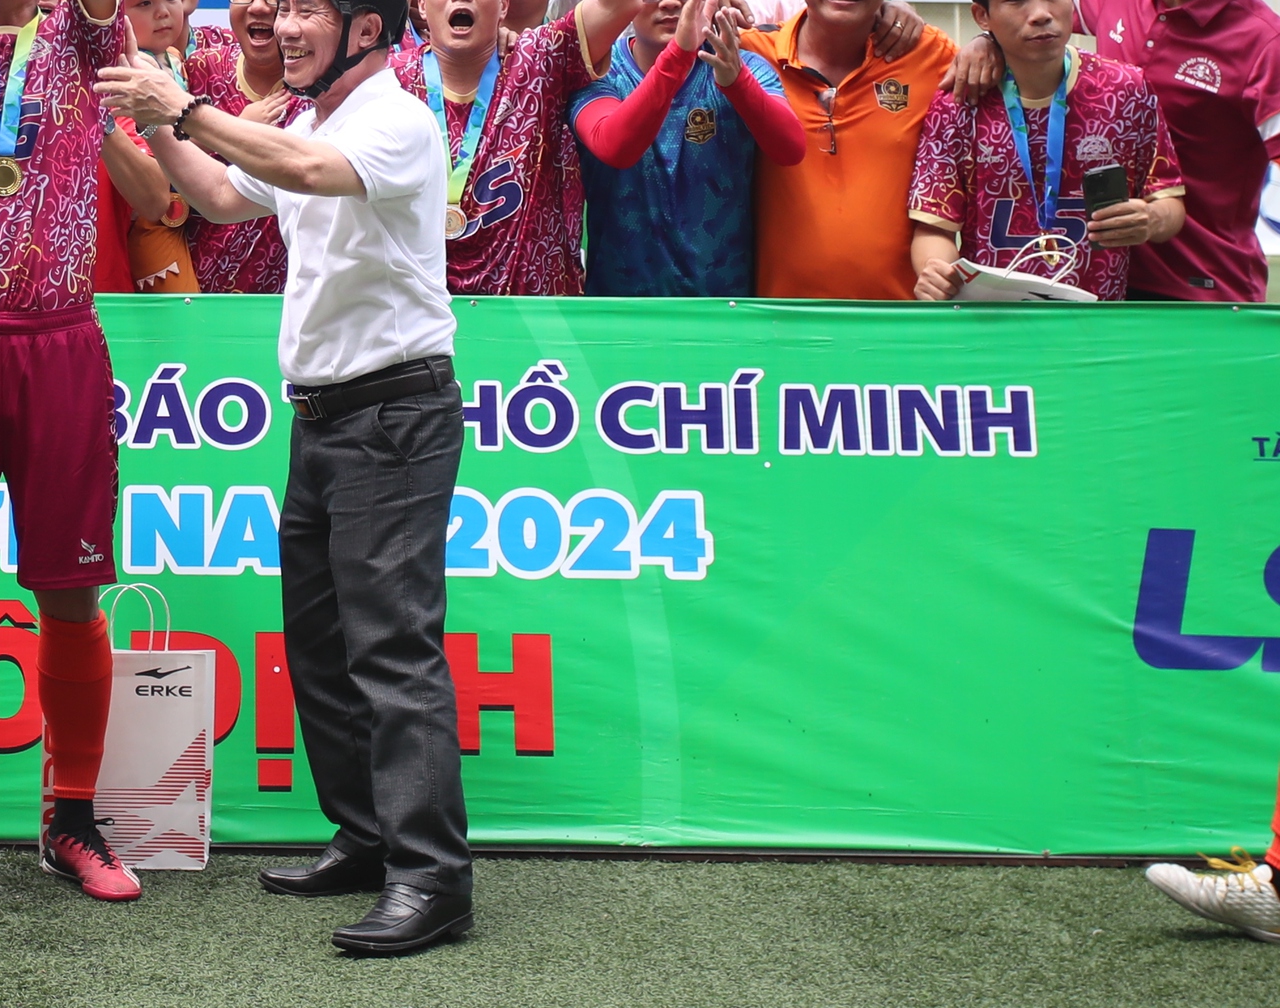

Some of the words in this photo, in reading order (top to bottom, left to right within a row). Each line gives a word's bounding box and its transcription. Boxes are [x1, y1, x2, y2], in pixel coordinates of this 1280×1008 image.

[596, 368, 765, 457] CHÍ
[779, 383, 1037, 458] MINH
[78, 553, 104, 565] KAMITO
[123, 485, 282, 576] NA
[446, 487, 714, 580] 2024
[1132, 527, 1280, 673] L
[135, 685, 193, 698] ERKE
